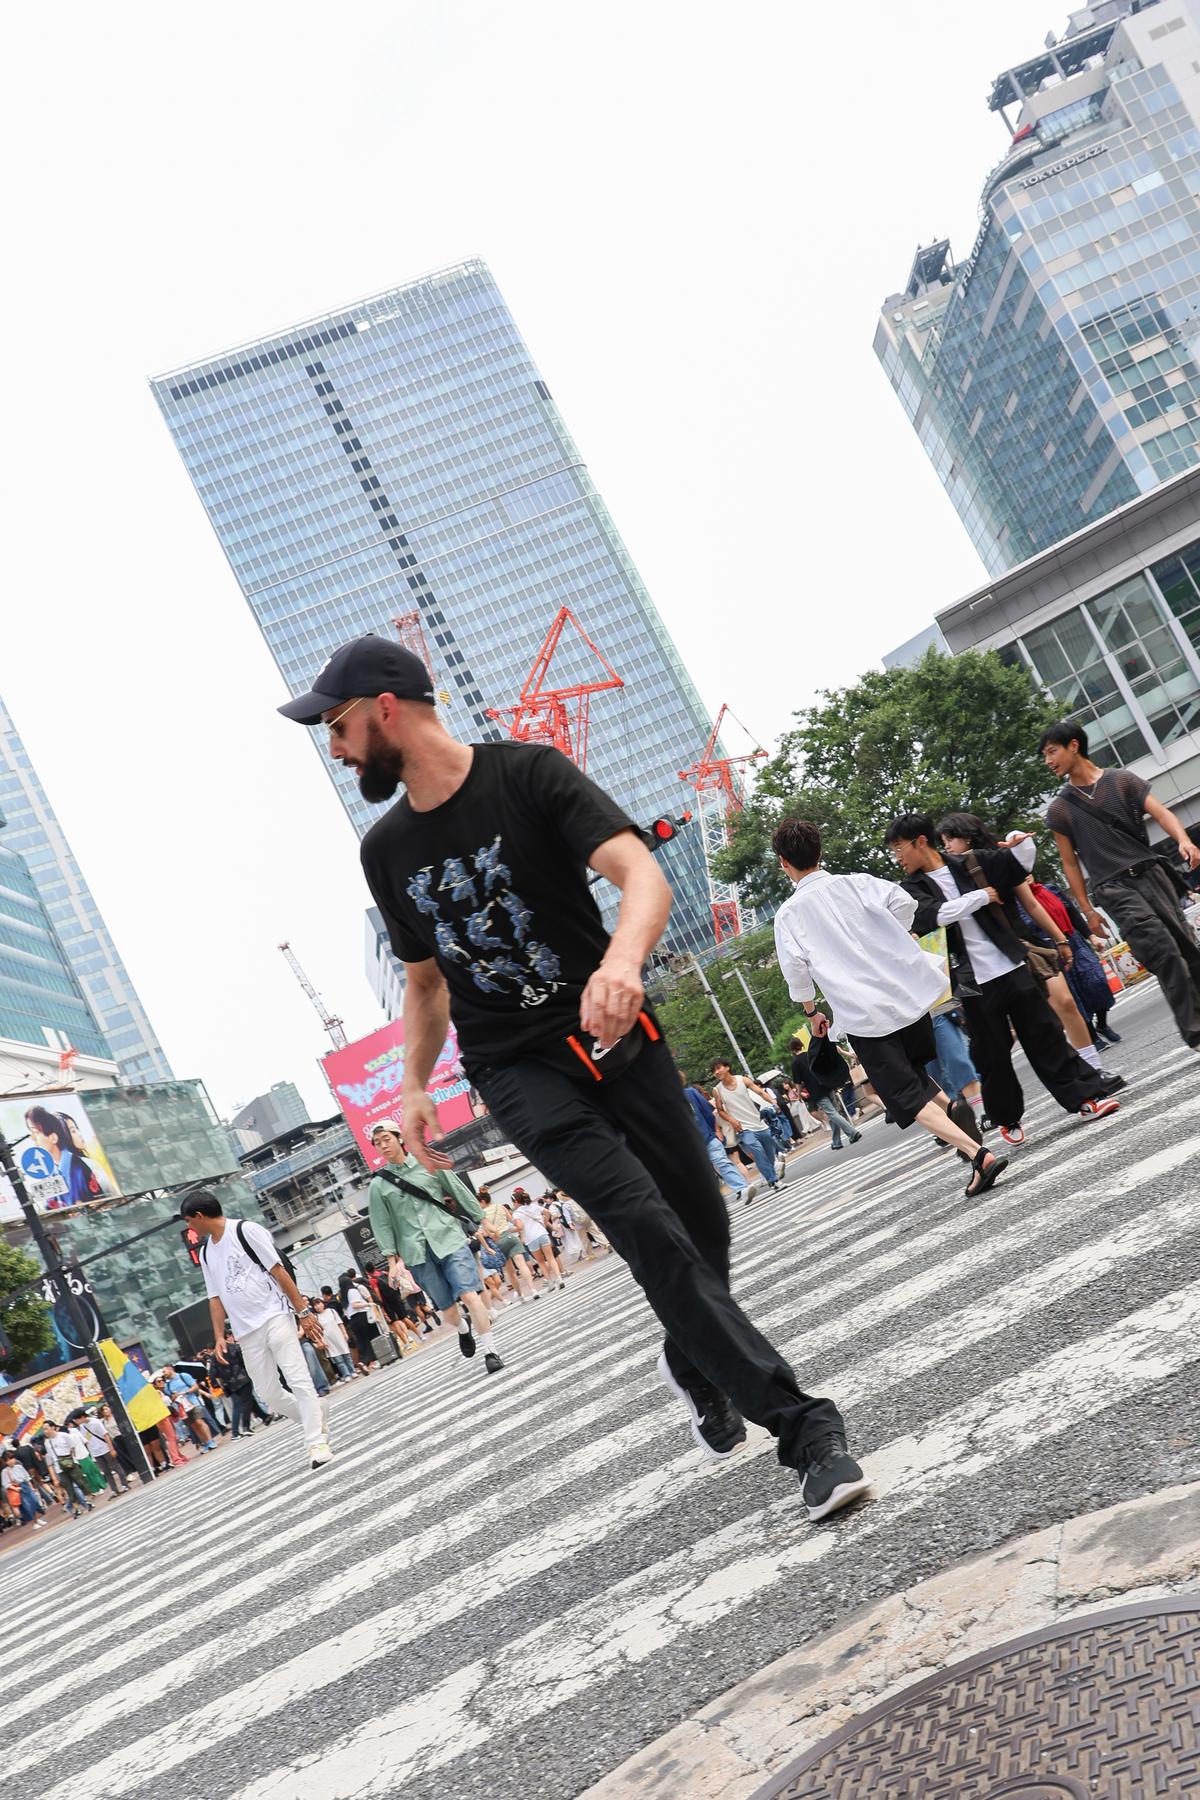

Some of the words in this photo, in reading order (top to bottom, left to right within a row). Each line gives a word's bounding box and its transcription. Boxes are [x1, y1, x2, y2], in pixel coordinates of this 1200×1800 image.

[1021, 165, 1066, 188] TOKYU
[1066, 144, 1109, 167] PLAZA
[961, 215, 990, 287] FUKURAS
